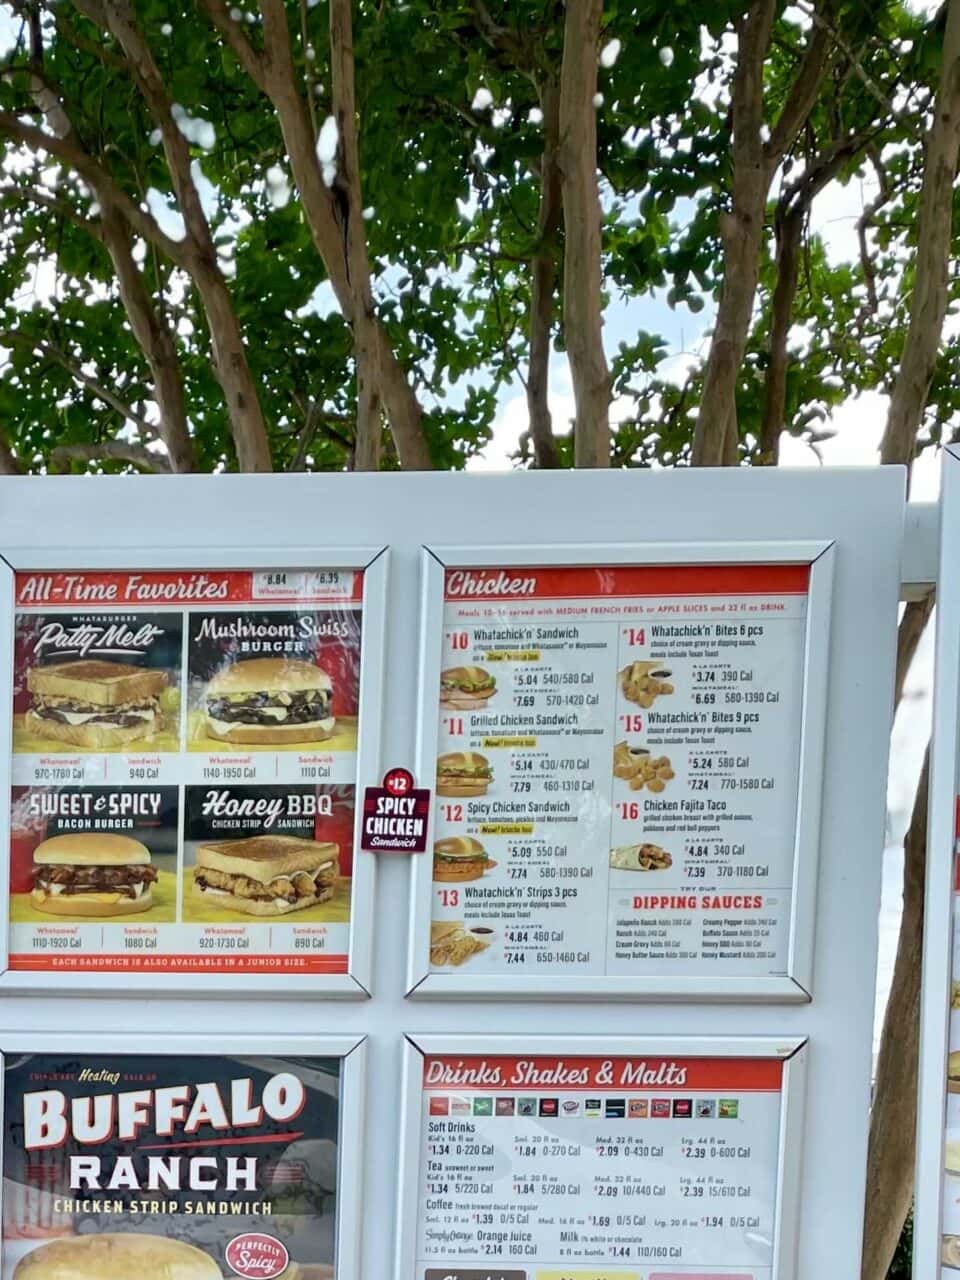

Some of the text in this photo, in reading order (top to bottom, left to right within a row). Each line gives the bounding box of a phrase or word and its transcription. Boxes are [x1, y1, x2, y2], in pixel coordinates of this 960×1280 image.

[20, 576, 228, 601] All-Time Favorites
[446, 570, 536, 595] Chicken
[196, 616, 348, 641] Mushroom Swiss
[537, 628, 579, 639] Sandwich
[715, 624, 738, 636] Bites
[33, 622, 164, 657] Patty Melt
[241, 641, 304, 651] BURGER
[722, 670, 736, 682] 390
[740, 670, 753, 681] Cal
[471, 714, 578, 726] Grilled Chicken Sandwich
[711, 712, 734, 723] Bites
[387, 777, 407, 791] #12
[29, 793, 161, 815] SWEET SPICY
[202, 790, 333, 828] Honey BBQ
[377, 798, 416, 815] SPICY
[467, 802, 490, 814] Spicy
[493, 802, 525, 813] Chicken
[528, 802, 570, 813] Sandwich
[644, 800, 727, 812] Chicken Fajita Taco
[58, 818, 133, 829] BACON BURGER
[212, 818, 314, 829] CHICKEN STRIP SANDWICH
[366, 817, 423, 836] CHICKEN
[370, 836, 416, 848] Sandwich
[527, 887, 551, 899] Strips
[633, 895, 763, 909] DIPPING SAUCES
[78, 1069, 121, 1085] Heating
[511, 1062, 589, 1084] Shakes
[595, 1063, 613, 1083] &
[620, 1064, 688, 1085] Malts
[23, 1073, 306, 1150] BUFFALO
[428, 1122, 475, 1133] Soft Drinks
[427, 1161, 442, 1171] Tea
[70, 1155, 259, 1191] RANCH
[54, 1200, 272, 1215] CHICKEN STRIP SANDWICH
[426, 1200, 453, 1210] Coffee
[477, 1231, 532, 1243] Orange Juice
[235, 1243, 281, 1256] PERFECTLY
[237, 1251, 277, 1273] Spicy
